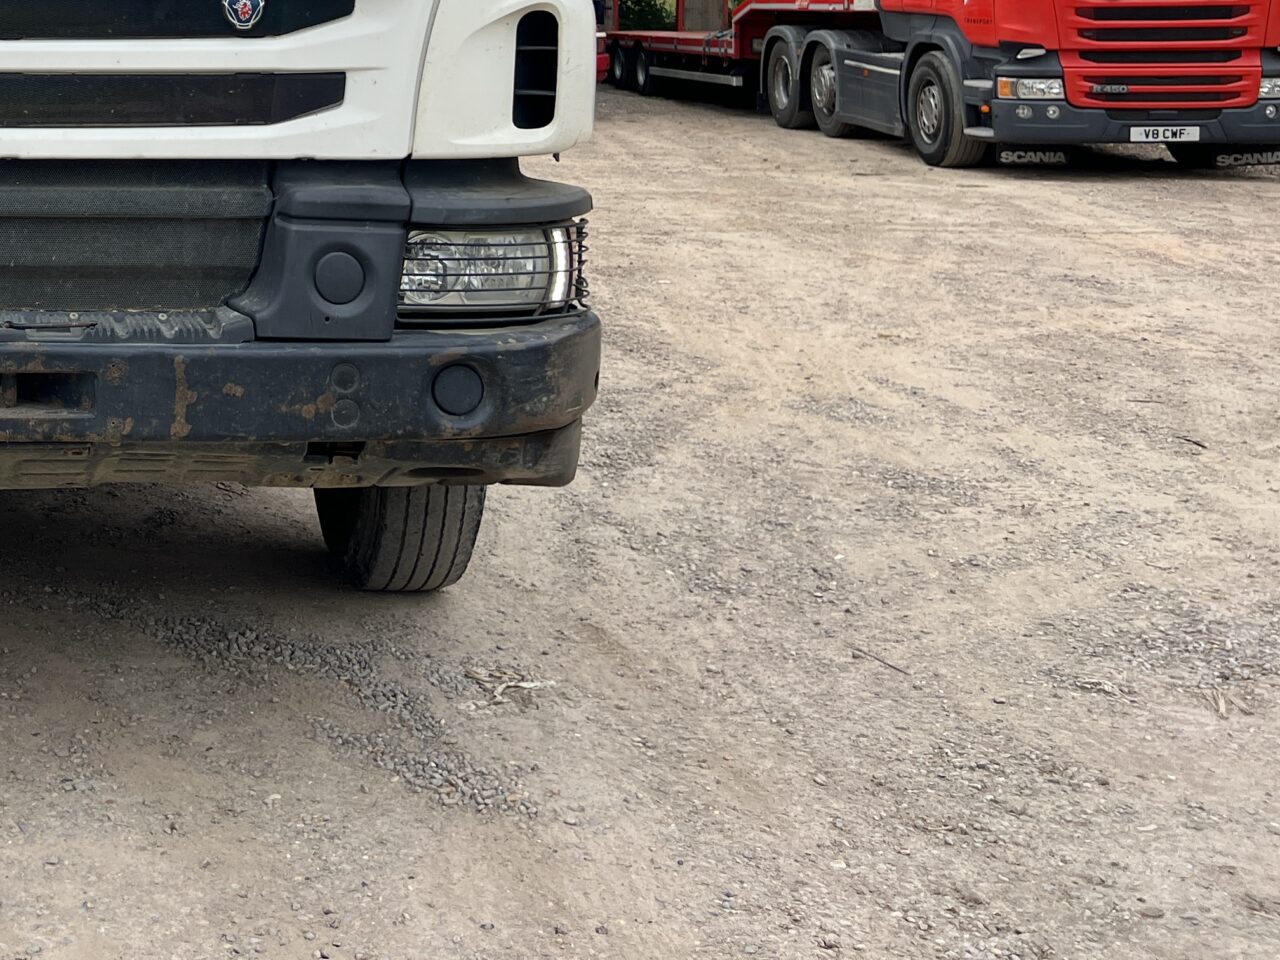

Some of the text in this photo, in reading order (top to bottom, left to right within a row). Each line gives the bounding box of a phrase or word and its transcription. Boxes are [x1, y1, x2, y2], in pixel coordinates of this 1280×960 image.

[1103, 84, 1128, 93] 450
[1143, 128, 1187, 139] V8 CWF
[1000, 151, 1066, 163] SCANIA
